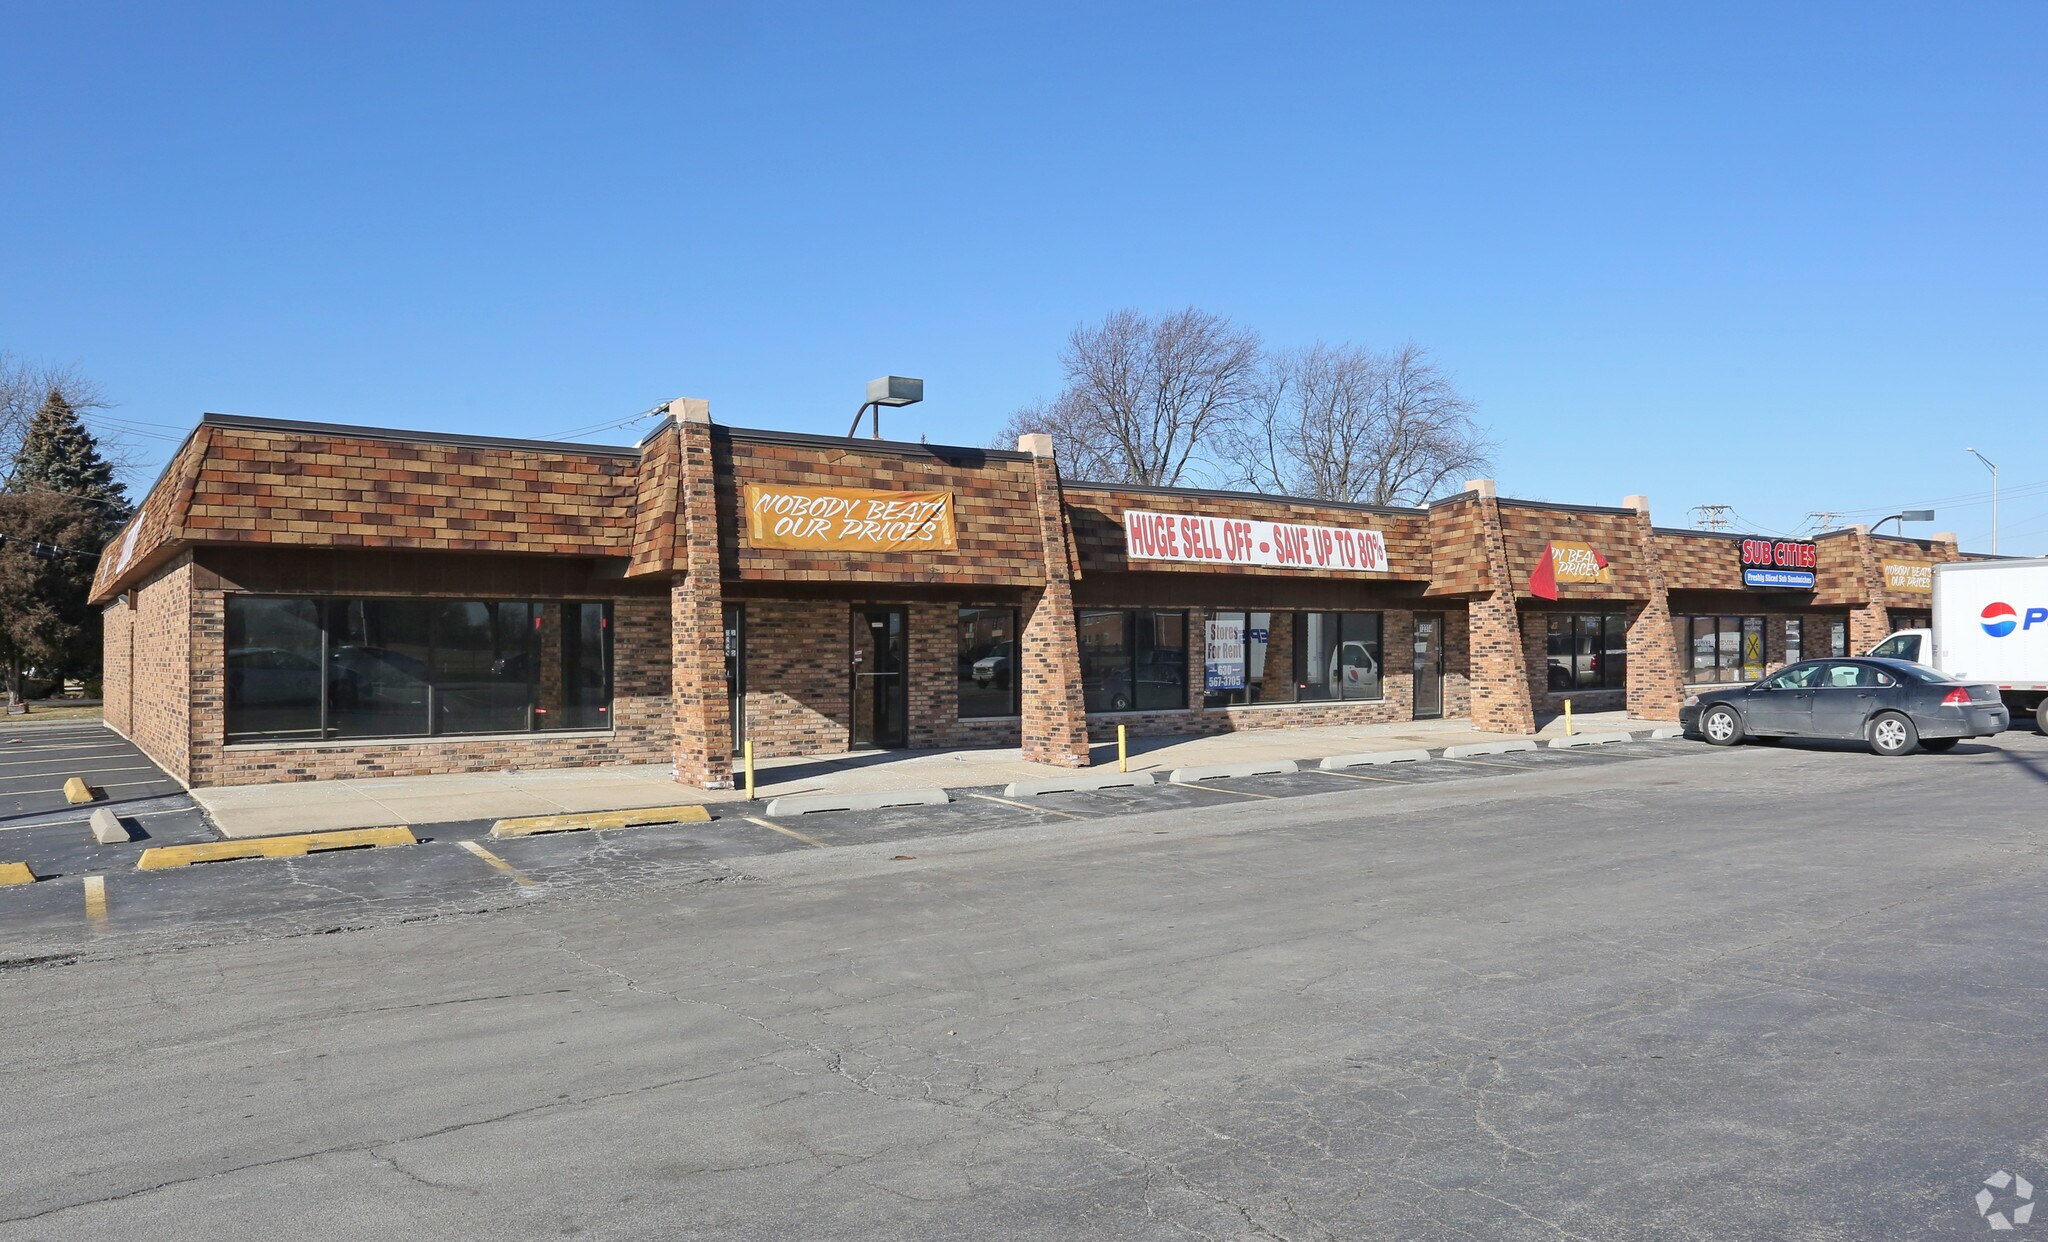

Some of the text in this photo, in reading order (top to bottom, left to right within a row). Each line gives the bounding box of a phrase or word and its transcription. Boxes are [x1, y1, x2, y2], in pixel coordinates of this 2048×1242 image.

[753, 493, 947, 522] NOBODY BEATS
[773, 517, 937, 543] OUR PRICES
[1129, 513, 1177, 557] HUGE
[1180, 517, 1222, 560] SELL
[1223, 520, 1252, 562] OFF
[1273, 524, 1312, 565] SAVE
[1312, 527, 1333, 566] UP
[1335, 530, 1356, 568] TO
[1357, 532, 1384, 569] 80%
[1742, 538, 1816, 568] SUB CITIES
[1557, 561, 1600, 577] PRICES
[1885, 564, 1910, 577] NOBODY
[1891, 575, 1931, 588] OUR PRICES
[2023, 608, 2048, 630] P
[1210, 623, 1239, 641] Stores
[1207, 642, 1242, 659] For Rent
[1208, 675, 1241, 687] 567-3705
